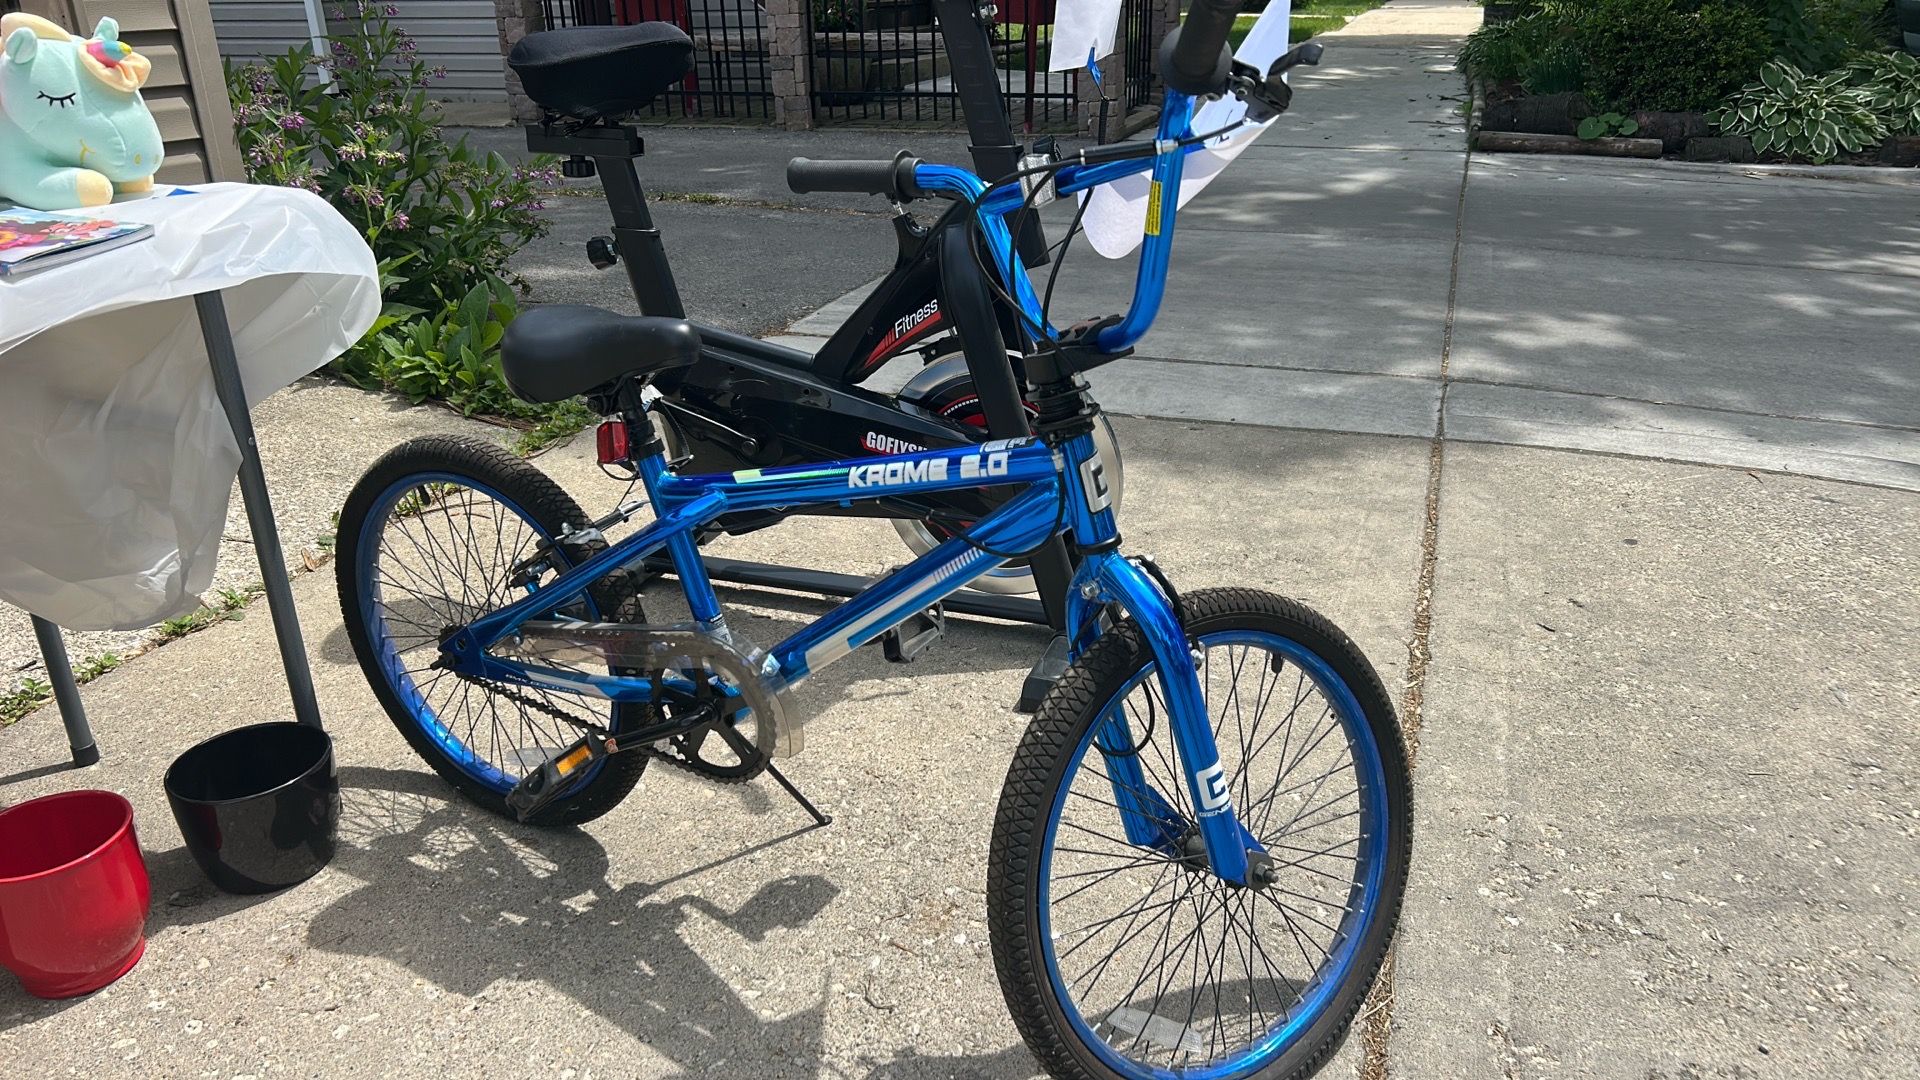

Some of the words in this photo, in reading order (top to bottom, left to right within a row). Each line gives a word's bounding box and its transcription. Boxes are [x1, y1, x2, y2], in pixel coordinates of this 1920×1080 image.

[894, 298, 938, 339] Fitness
[866, 431, 928, 455] GOFLYS
[848, 457, 949, 489] KROME
[960, 451, 1009, 479] 2.0
